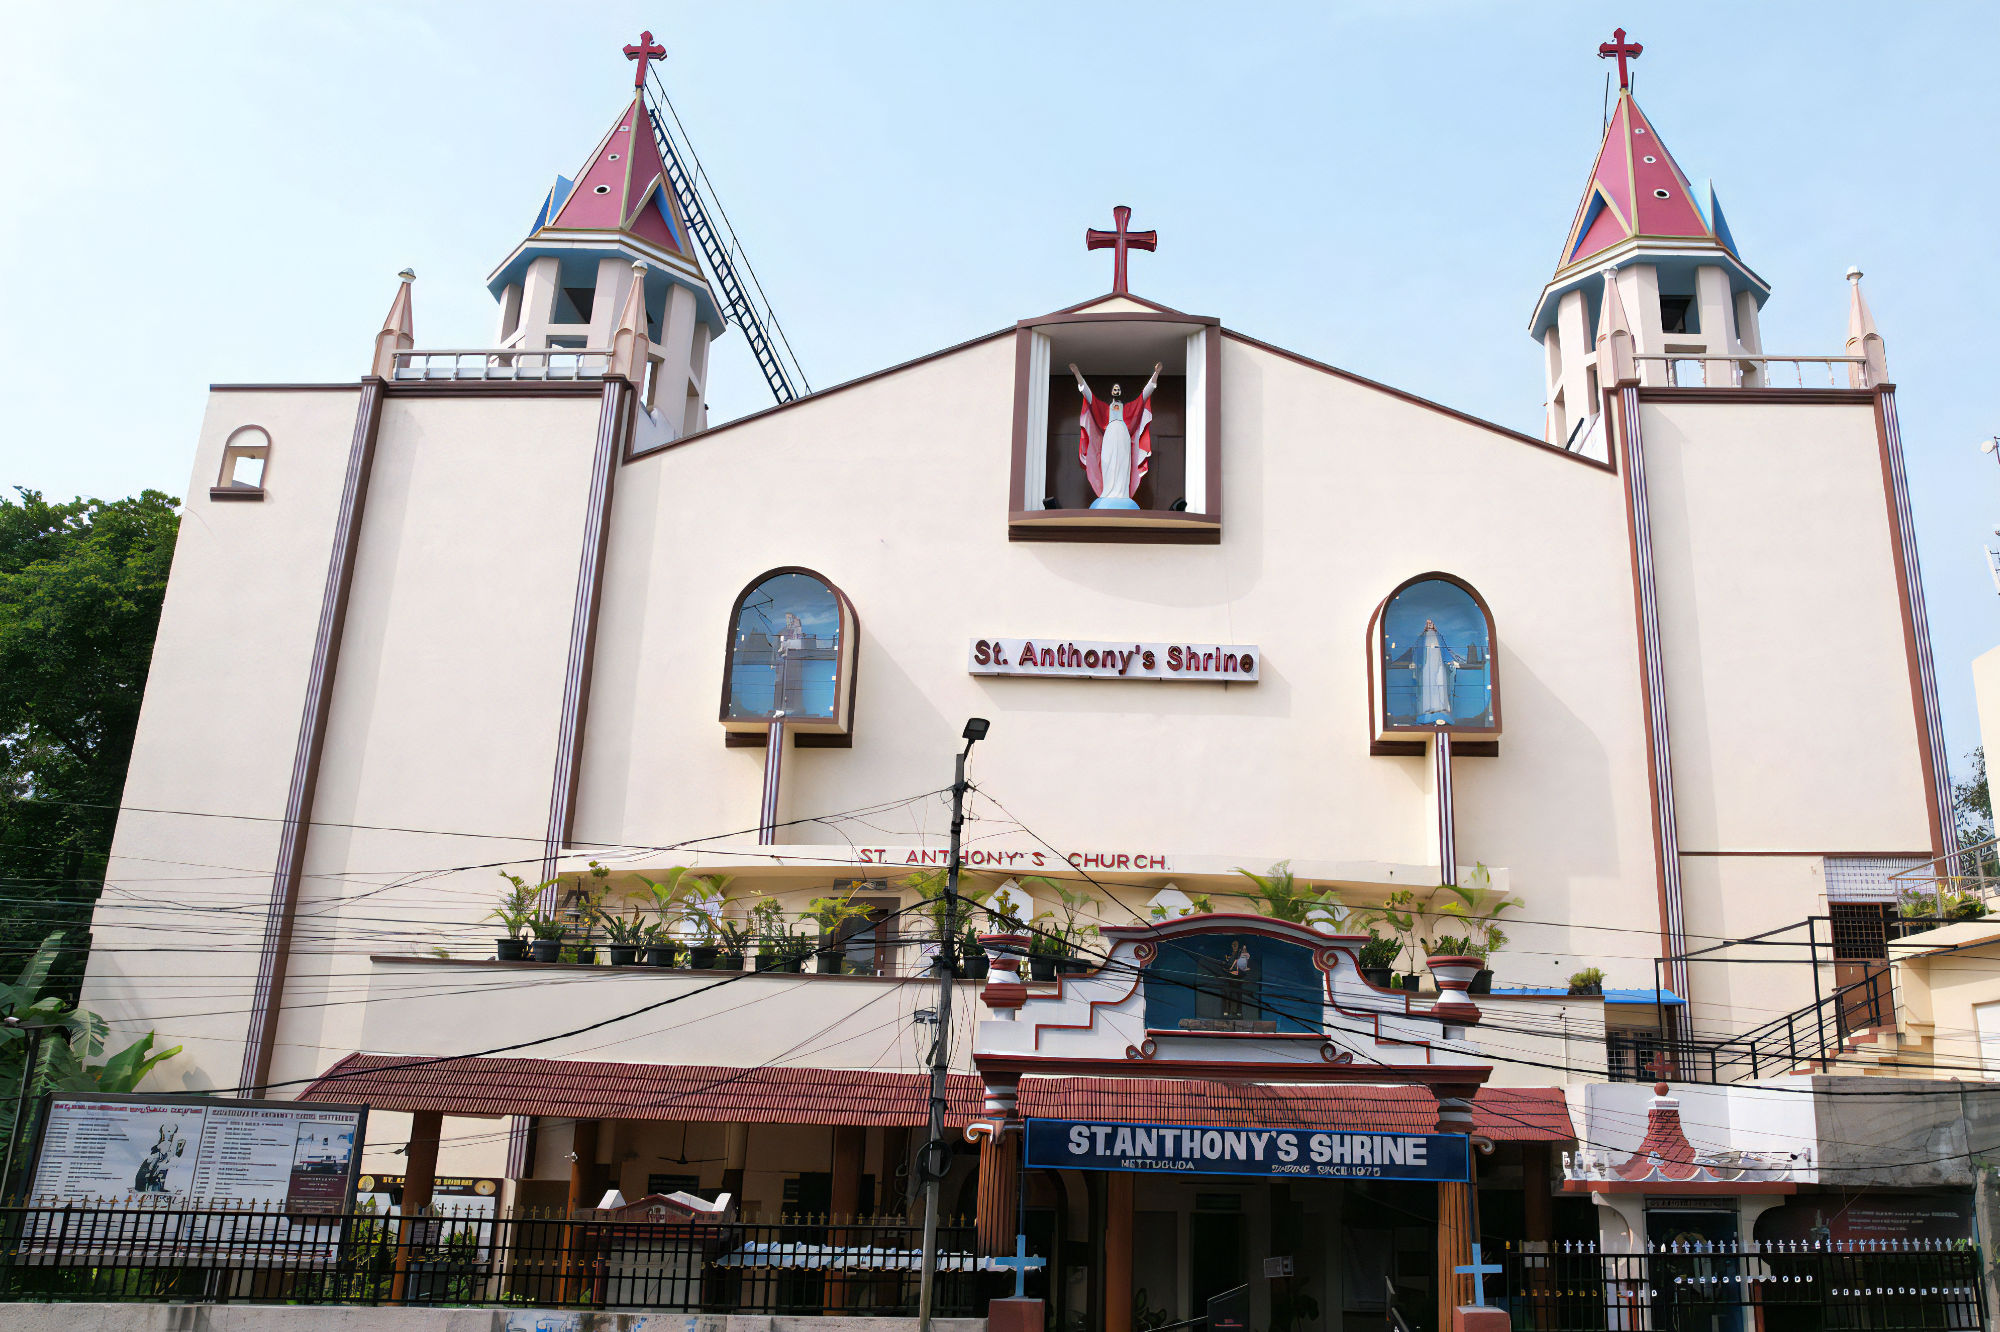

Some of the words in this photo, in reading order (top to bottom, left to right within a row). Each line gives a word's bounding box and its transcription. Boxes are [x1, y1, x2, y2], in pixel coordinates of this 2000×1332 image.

[973, 639, 1008, 666] St.
[1018, 641, 1156, 676] Anthony's
[1166, 645, 1254, 674] Shrine
[859, 848, 888, 864] ST.
[1309, 1134, 1428, 1167] SHRINE
